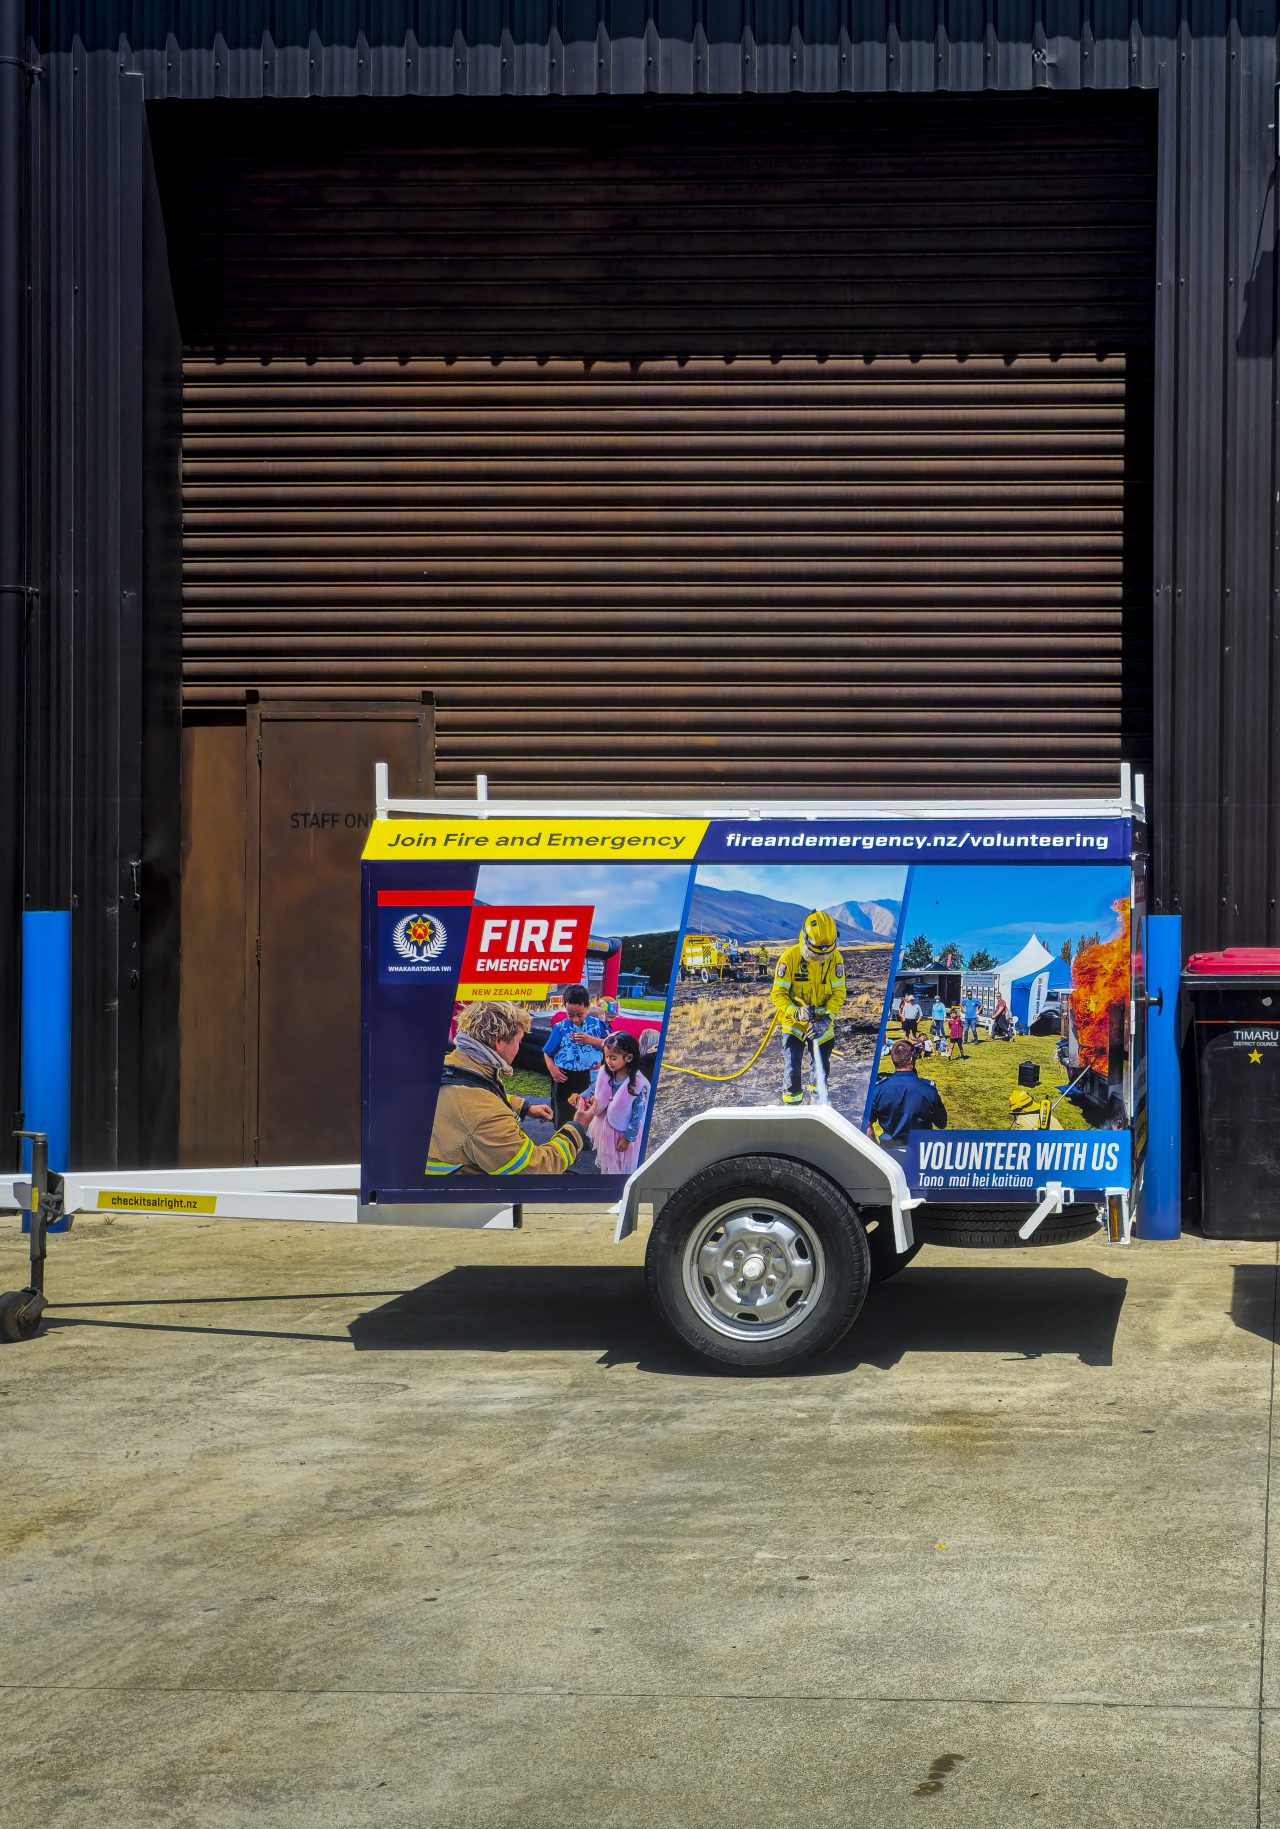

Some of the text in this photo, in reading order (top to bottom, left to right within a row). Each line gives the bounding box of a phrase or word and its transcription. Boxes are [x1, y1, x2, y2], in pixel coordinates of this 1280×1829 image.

[290, 812, 340, 829] STAFF
[387, 832, 686, 849] Join Fire and Emergency
[727, 833, 1108, 849] fireandemergency.nz/volunteering
[480, 920, 577, 952] FIRE
[475, 958, 571, 972] EMERGENCY
[471, 988, 533, 996] NEW ZEALAND
[1233, 1030, 1279, 1041] TIMARU
[920, 1142, 1119, 1170] VOLUNTEER WITH US
[919, 1173, 1033, 1187] Tono mai hei kaitūao
[111, 1196, 198, 1210] checkitsalright.nz
